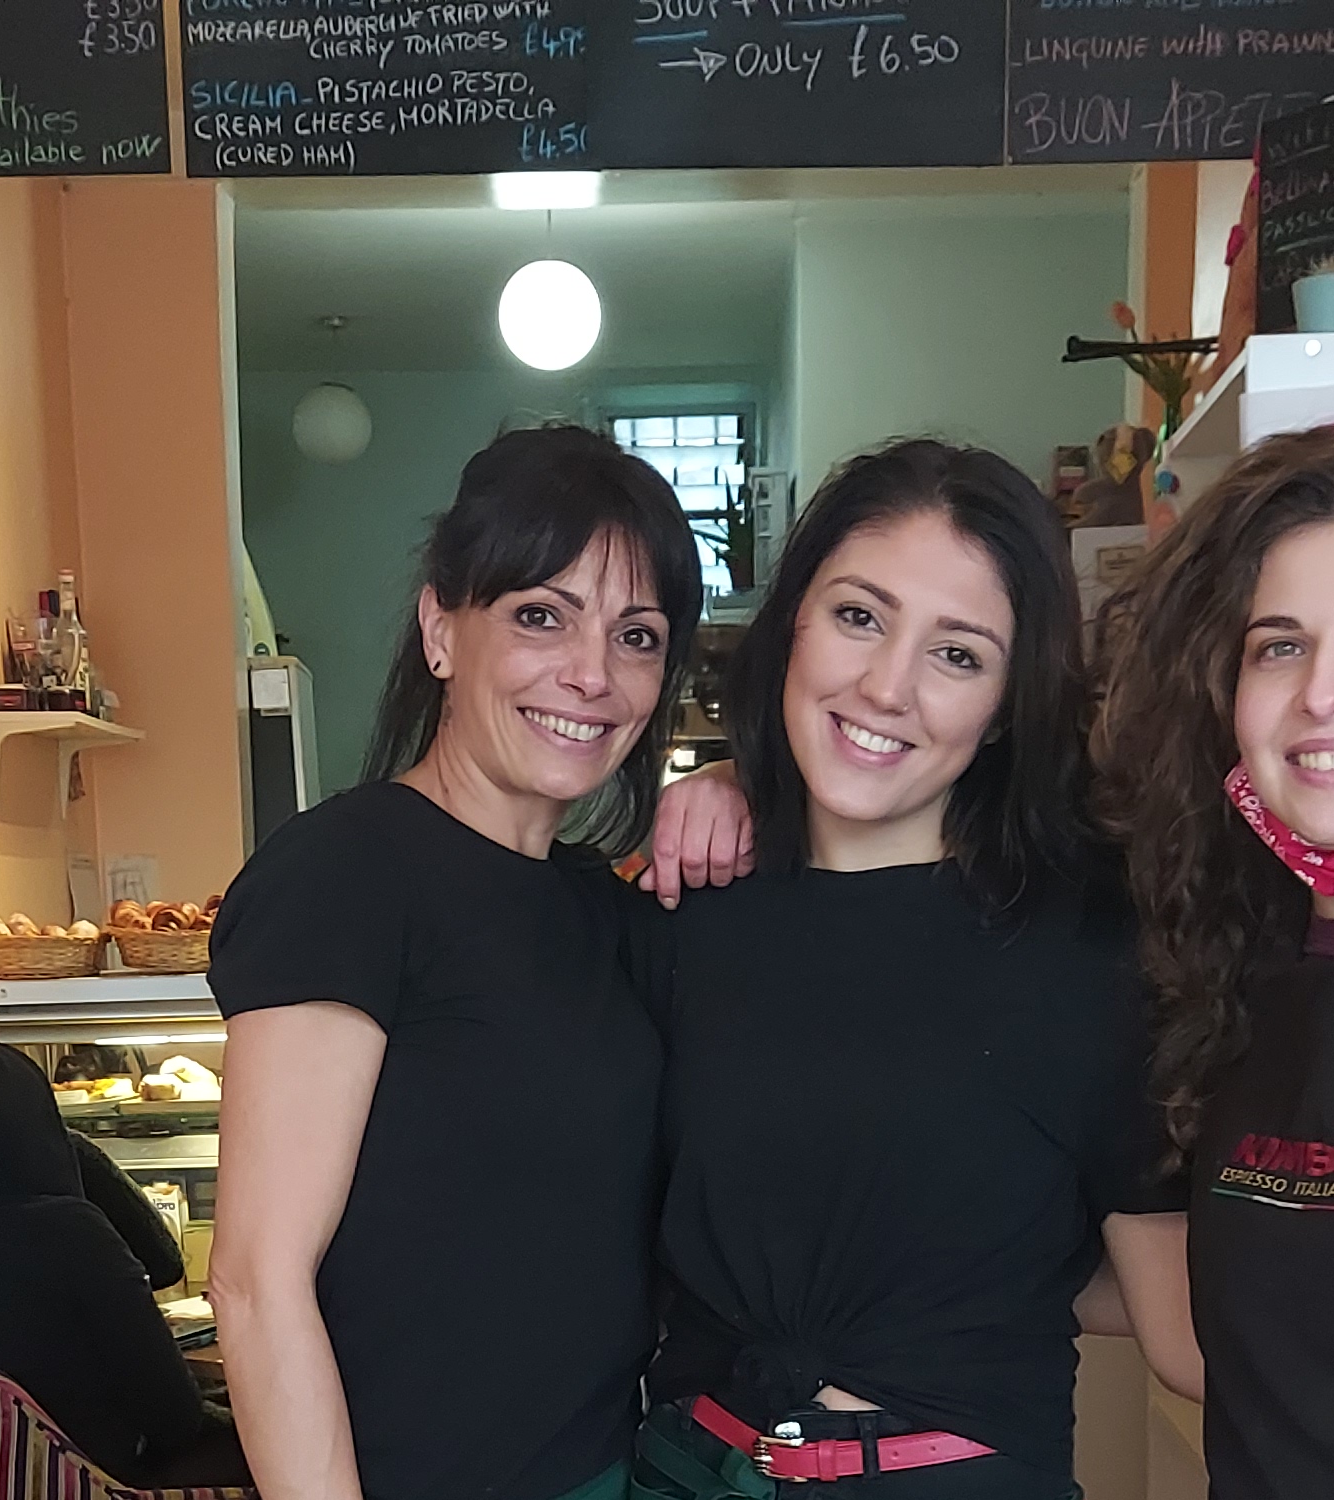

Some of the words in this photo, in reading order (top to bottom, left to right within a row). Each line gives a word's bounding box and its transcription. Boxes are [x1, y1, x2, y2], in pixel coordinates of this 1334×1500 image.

[309, 34, 396, 70] CHERRY
[404, 30, 510, 55] TOMATOES
[1024, 36, 1149, 69] LINGUINE
[192, 80, 299, 109] SICILIA
[317, 72, 445, 105] PISTACHIO
[193, 113, 283, 140] CREAM
[1013, 91, 1131, 153] BUON
[101, 135, 162, 164] now
[215, 140, 294, 171] (CURED
[302, 140, 357, 171] HAM)
[1219, 1166, 1288, 1194] ESPRESSO
